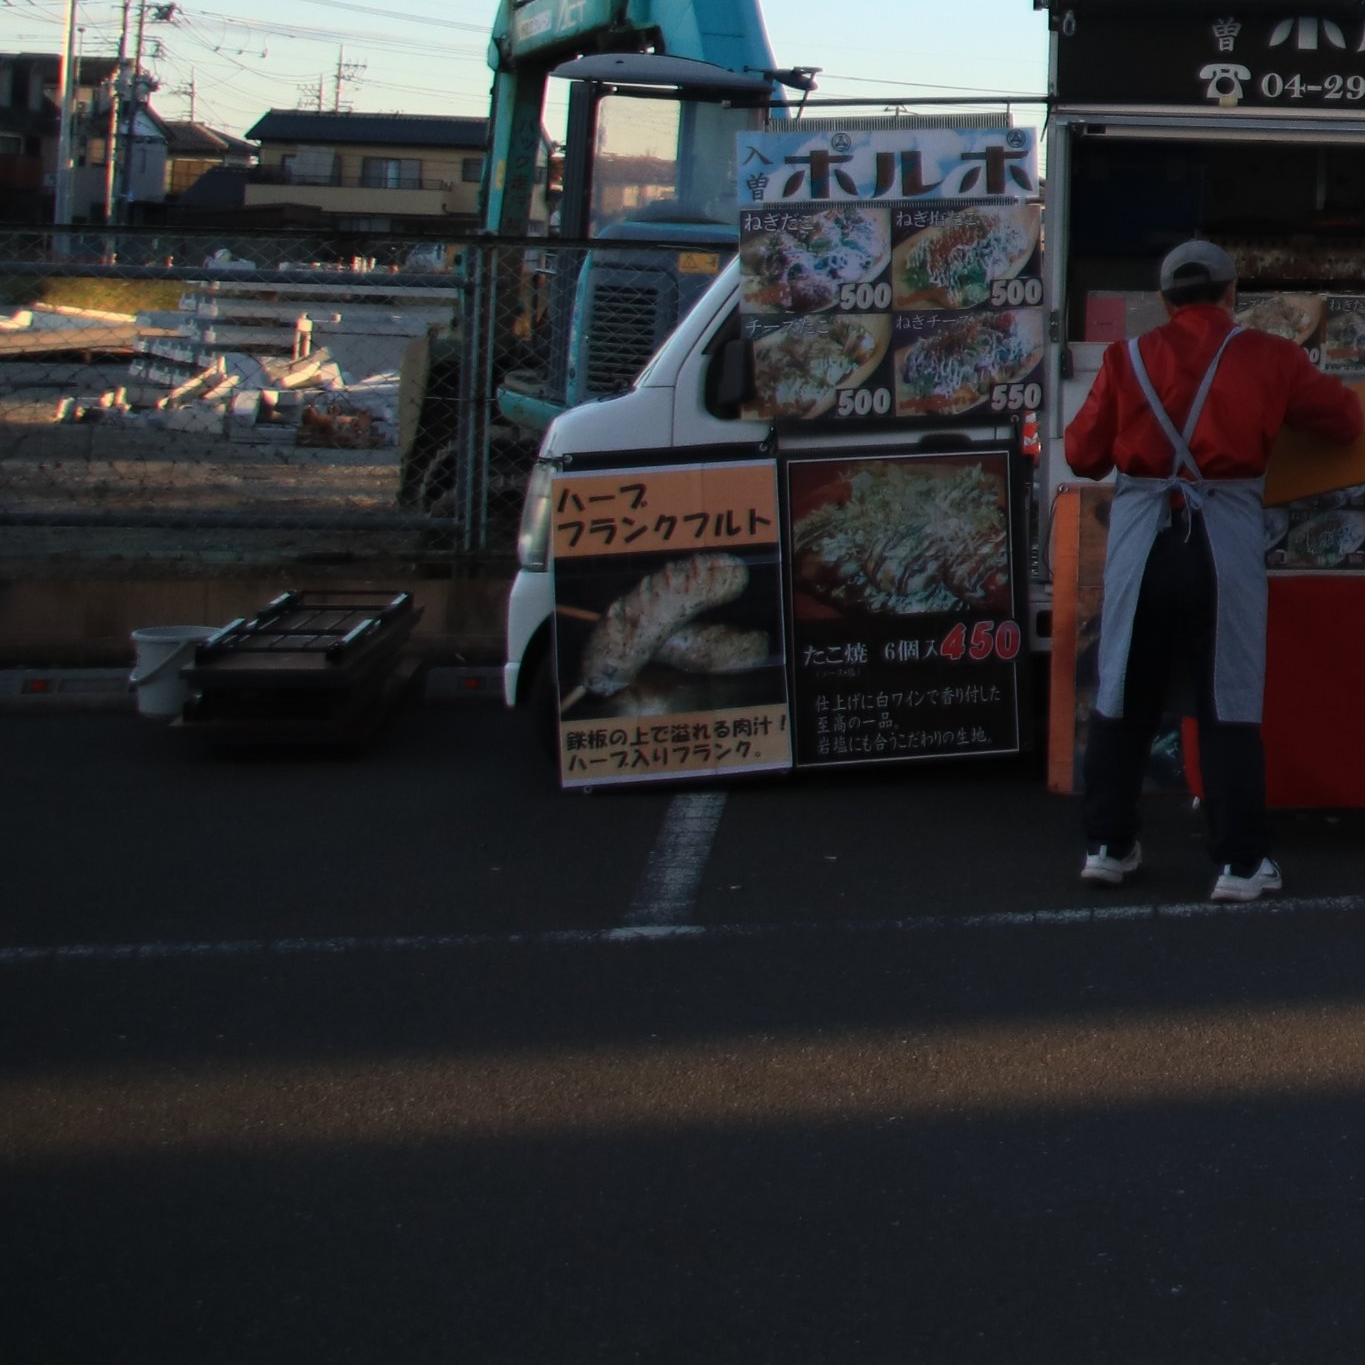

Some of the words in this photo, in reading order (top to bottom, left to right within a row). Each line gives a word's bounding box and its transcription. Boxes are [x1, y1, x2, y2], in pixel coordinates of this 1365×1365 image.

[743, 146, 774, 202] 入曽
[782, 130, 1033, 200] ポルポ
[840, 282, 892, 310] 500
[991, 279, 1043, 306] 500
[838, 387, 891, 417] 500
[990, 383, 1043, 410] 550
[557, 508, 772, 548] フランクフルト
[803, 642, 869, 667] たこ焼
[939, 619, 1022, 662] 450
[815, 684, 1001, 714] 仕上げに白ワインで香り付した
[816, 711, 900, 735] 至高の一品。
[816, 725, 993, 756] 岩塩にも合うこだわりの生地。
